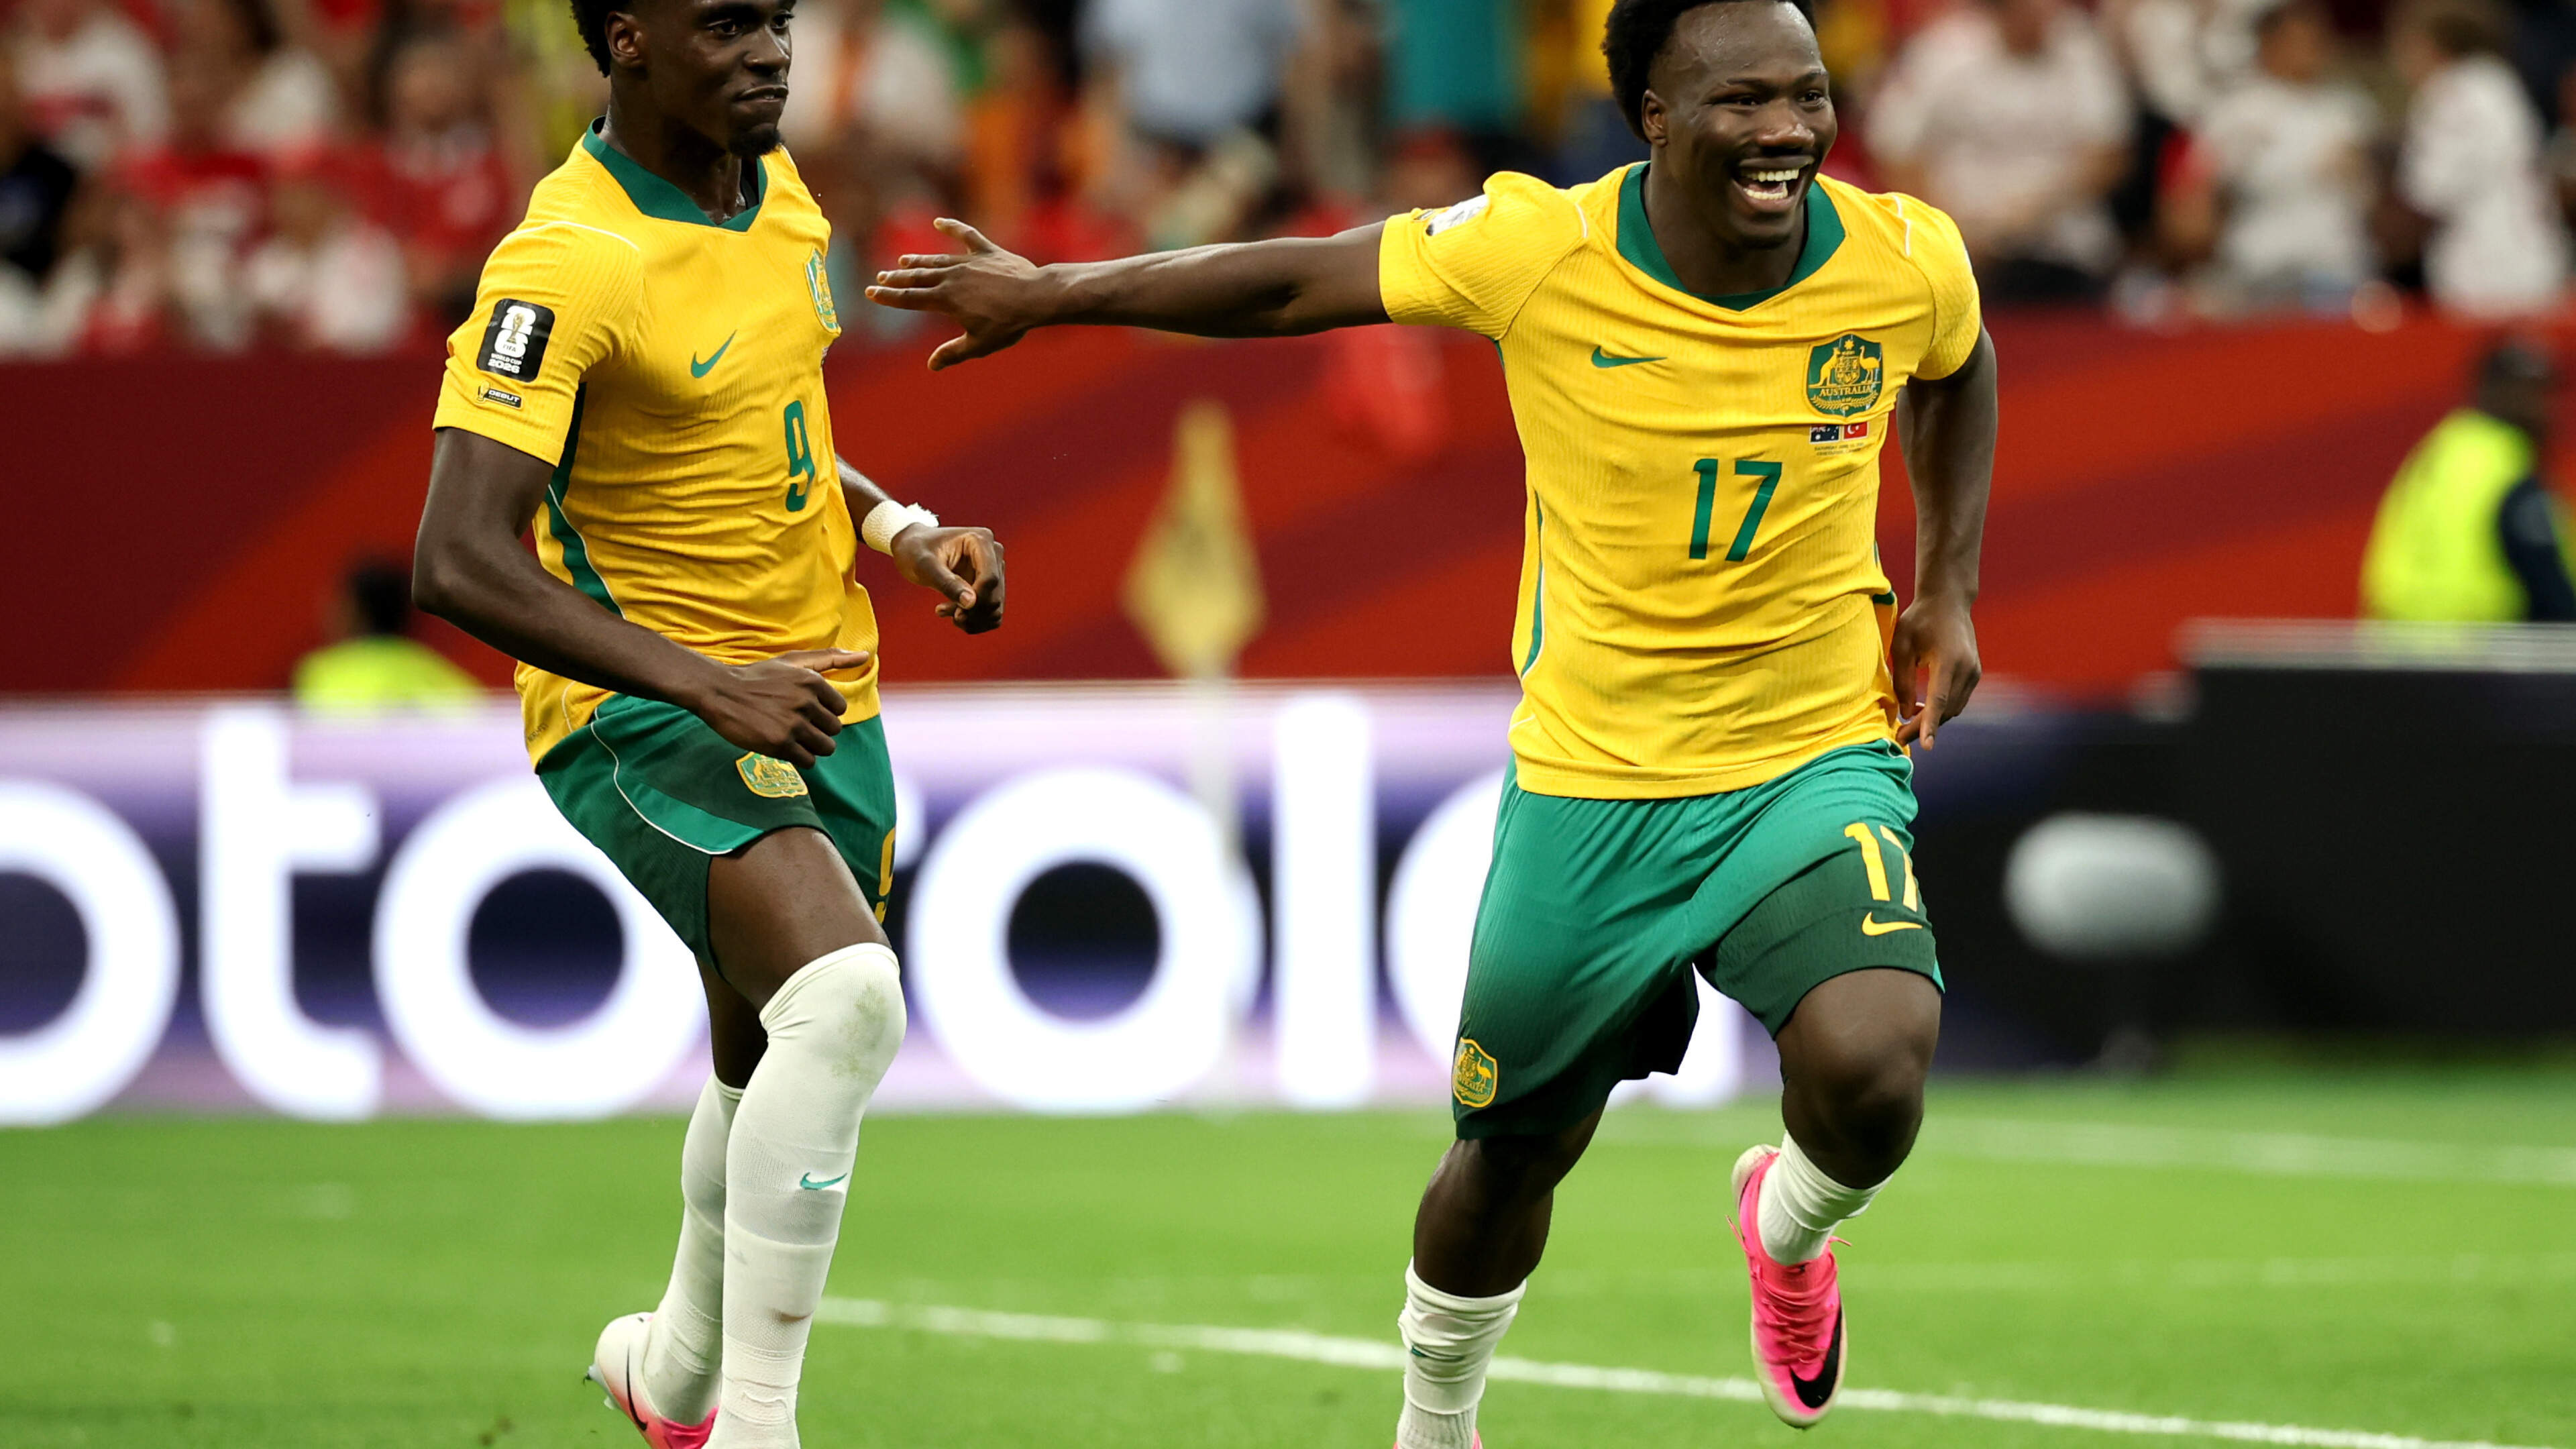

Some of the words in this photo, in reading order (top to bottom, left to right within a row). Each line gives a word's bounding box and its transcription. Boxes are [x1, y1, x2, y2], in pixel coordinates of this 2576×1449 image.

[502, 343, 517, 352] FIFA
[488, 358, 521, 374] 2026
[510, 358, 523, 366] CUP
[488, 390, 520, 402] DEBUT
[1819, 385, 1872, 396] AUSTRALIA
[784, 400, 815, 512] 9
[1688, 458, 1782, 562] 17
[1843, 822, 1918, 912] 17
[0, 694, 1746, 1128] otool
